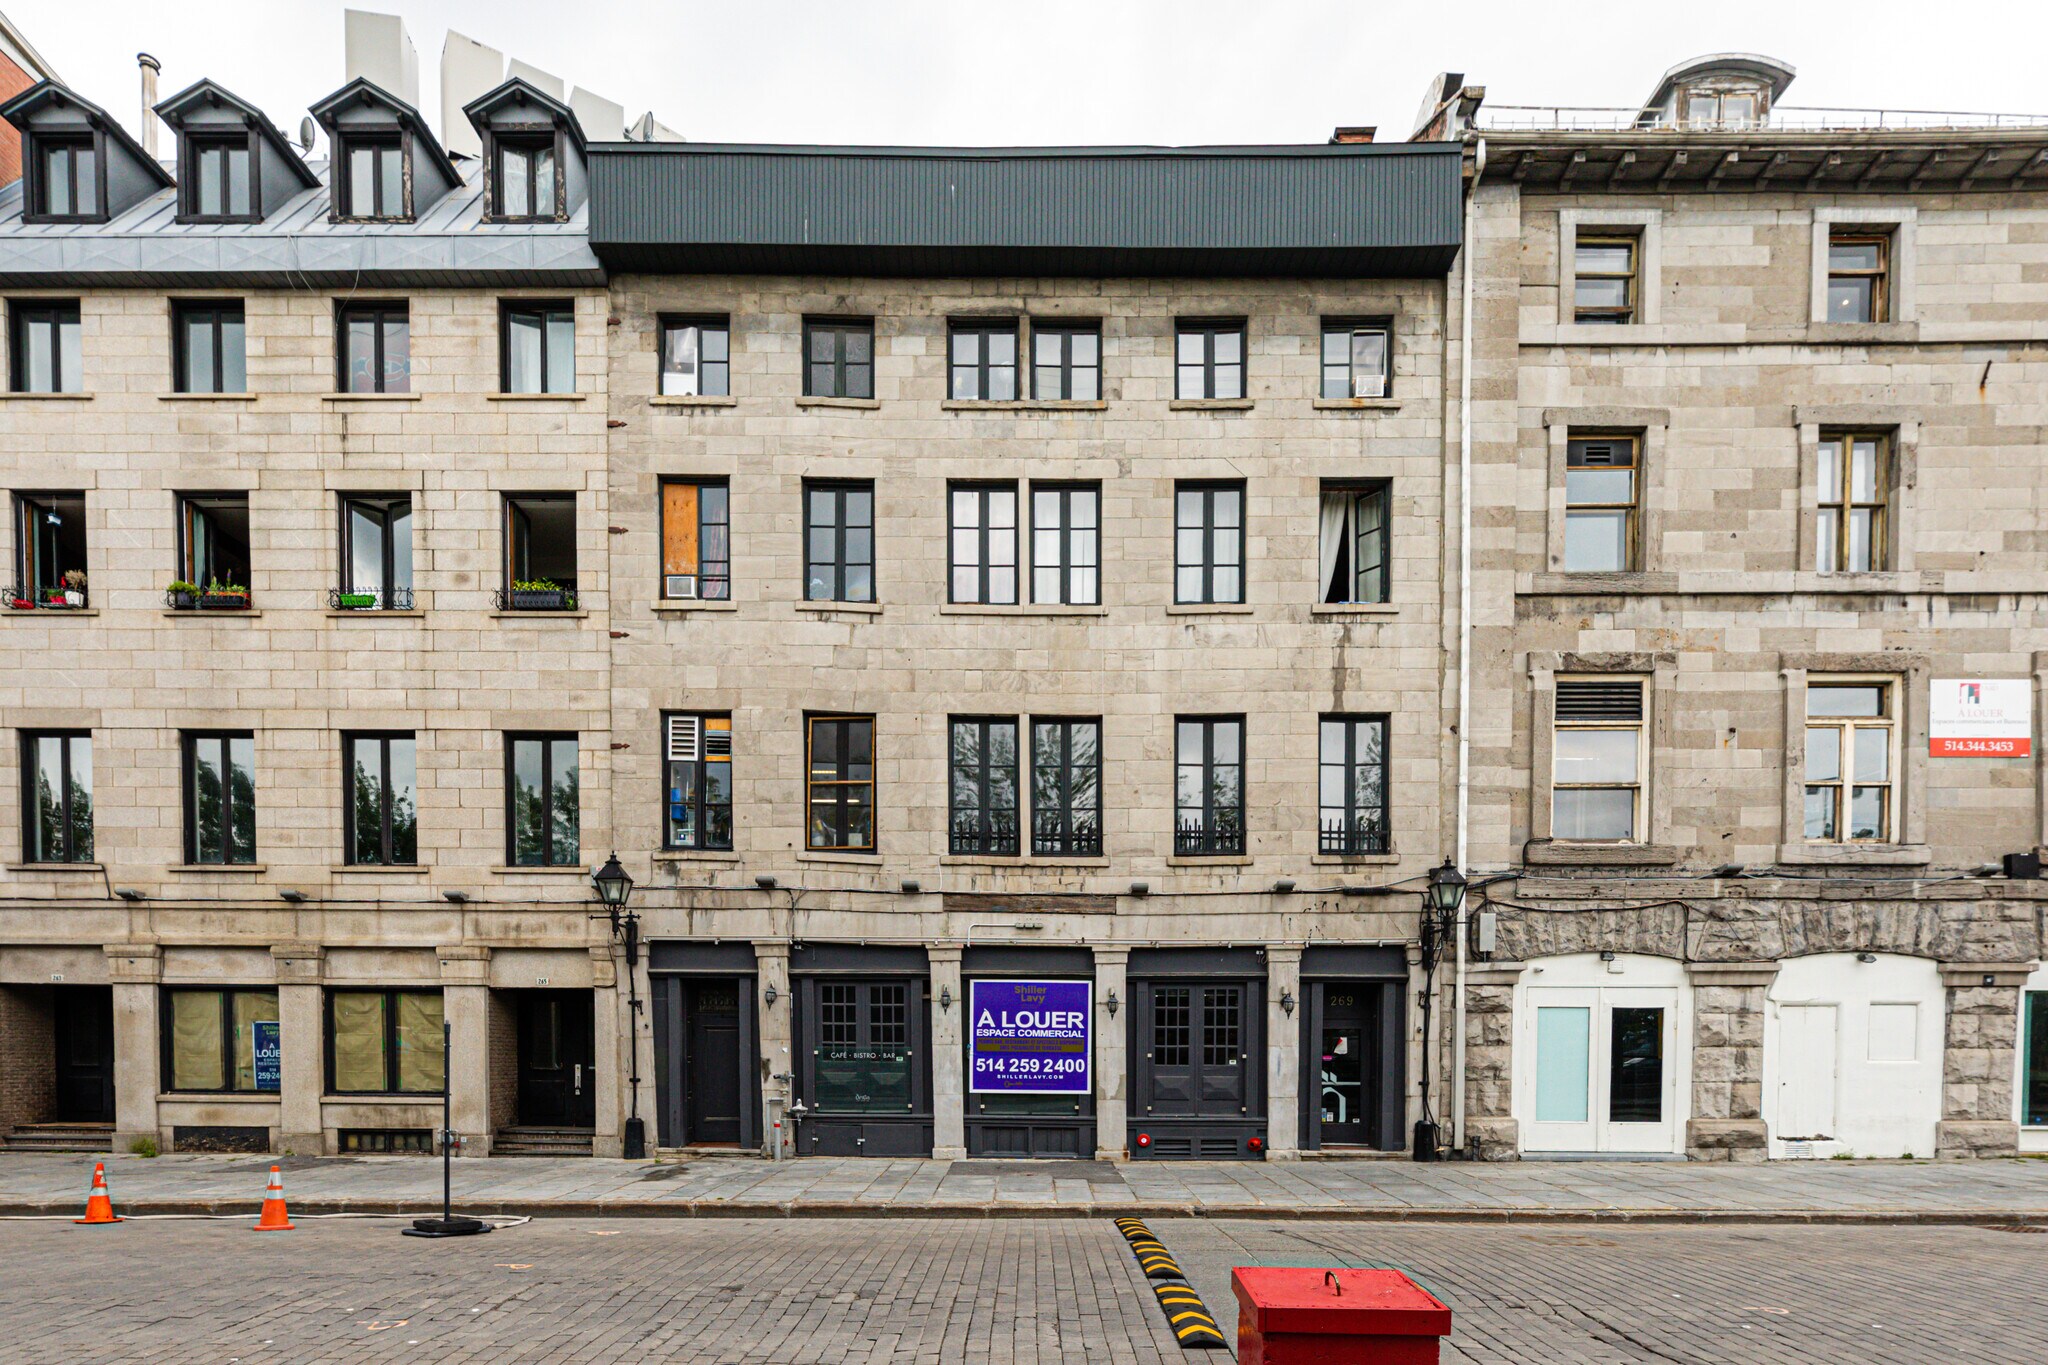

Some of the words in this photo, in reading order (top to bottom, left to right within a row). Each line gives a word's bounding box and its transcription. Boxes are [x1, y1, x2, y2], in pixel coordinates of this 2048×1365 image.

[1967, 709, 2003, 718] LOUER
[1944, 740, 2014, 752] 514.344.3453
[1014, 985, 1047, 994] Shiller
[1021, 994, 1045, 1004] Lavy
[1330, 995, 1354, 1006] 269
[976, 1008, 996, 1028] À
[1001, 1010, 1085, 1029] LOUER
[976, 1029, 1016, 1037] ESPACE
[1017, 1029, 1085, 1038] COMMERCIAL
[256, 1049, 281, 1058] LOUE
[830, 1051, 847, 1059] CAFÉ
[975, 1058, 1005, 1073] 514
[1009, 1058, 1040, 1073] 259
[1043, 1058, 1085, 1073] 2400
[258, 1072, 280, 1081] 259-24
